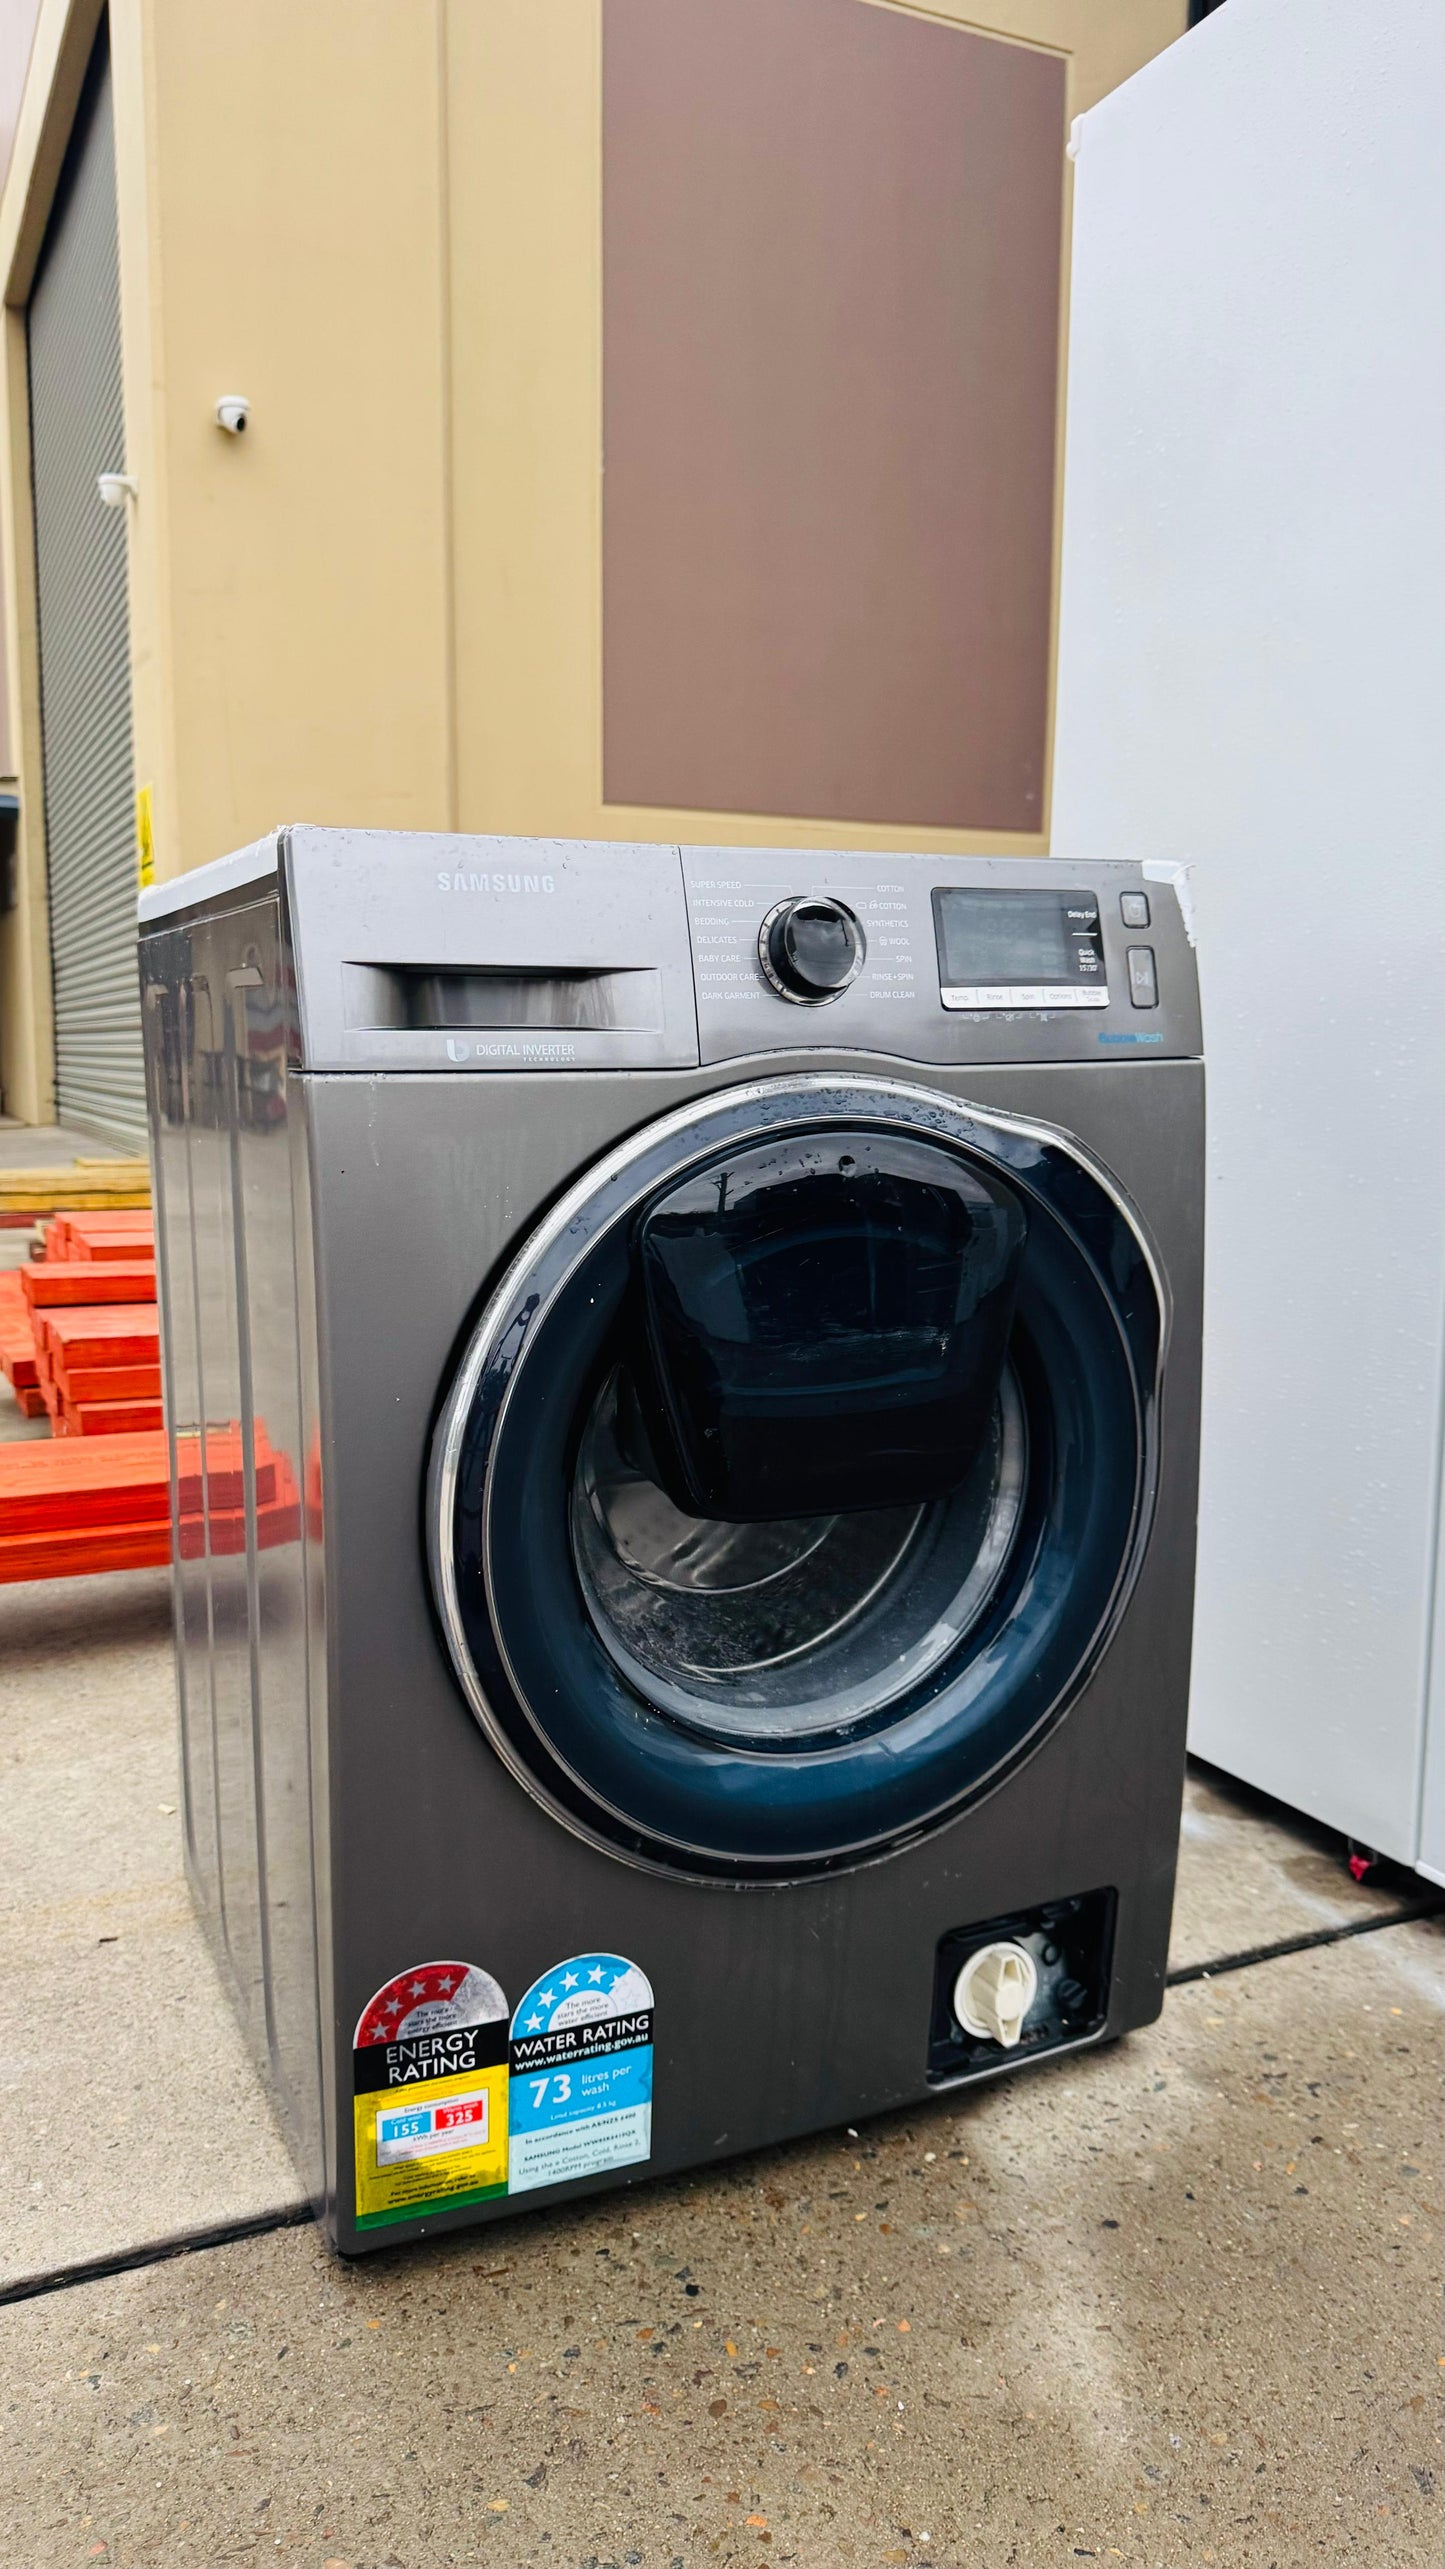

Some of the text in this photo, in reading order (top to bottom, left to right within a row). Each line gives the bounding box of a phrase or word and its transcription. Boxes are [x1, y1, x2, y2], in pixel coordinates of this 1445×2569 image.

[437, 872, 555, 893] SAMSUNG
[717, 881, 741, 889] SPEED
[1067, 911, 1084, 919] Delay
[700, 973, 759, 981] OUTDOOR CARE
[870, 991, 915, 999] DRUM CLEAN
[476, 1044, 575, 1055] DIGITAL INVERTER
[557, 2003, 609, 2019] stars the more
[566, 1998, 601, 2009] The more
[416, 2010, 429, 2018] The
[558, 2010, 608, 2026] water efficient
[514, 2015, 649, 2058] WATER RATING
[386, 2029, 479, 2064] ENERGY
[515, 2033, 648, 2071] www.waterrating.gov.au
[389, 2051, 476, 2084] RATING
[582, 2065, 632, 2085] litres per
[529, 2074, 572, 2108] 73
[581, 2082, 610, 2097] wash
[446, 2109, 473, 2126] 325
[393, 2121, 419, 2138] 155
[519, 2165, 540, 2176] Using
